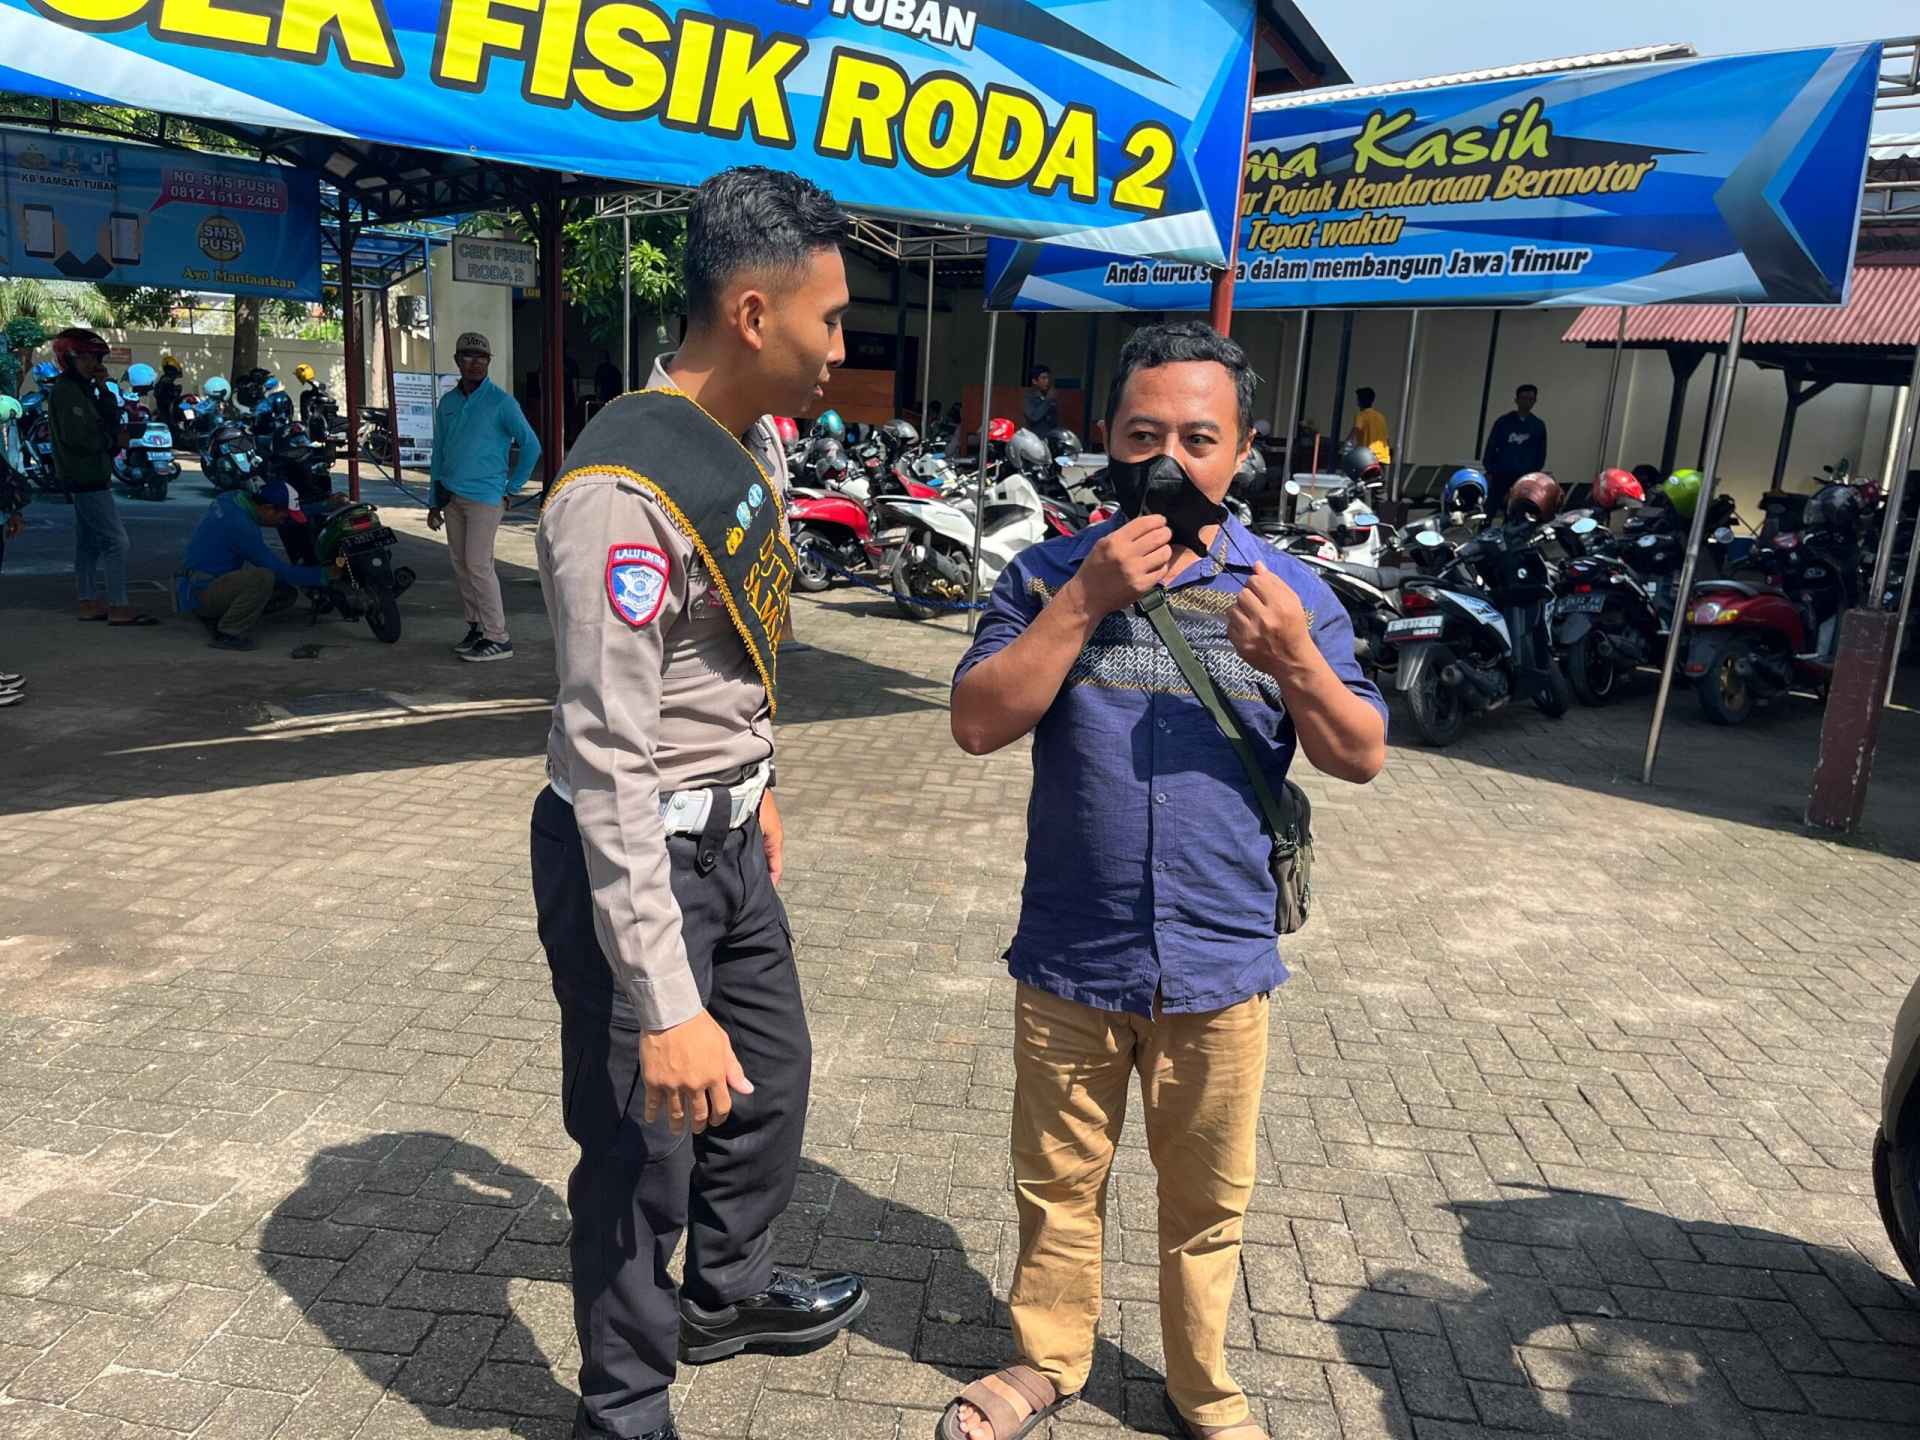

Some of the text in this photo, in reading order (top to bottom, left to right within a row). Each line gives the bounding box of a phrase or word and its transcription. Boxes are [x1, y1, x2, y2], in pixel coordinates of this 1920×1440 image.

[440, 0, 803, 142] FISIK
[820, 55, 1095, 198] RODA
[1113, 127, 1175, 210] 2
[1352, 101, 1550, 174] Kasih
[39, 175, 81, 187] SAMSAT
[170, 185, 206, 200] 0812
[203, 175, 233, 189] SMS
[238, 179, 276, 193] PUSH
[1262, 179, 1336, 217] Pajak
[1338, 173, 1493, 210] Kendaraan
[1493, 160, 1654, 200] Bermotor
[200, 225, 243, 253] SMS PUSH
[1247, 213, 1404, 253] Tepat waktu
[183, 266, 209, 281] Ayo
[1106, 264, 1148, 284] Anda
[1152, 264, 1196, 282] turut
[1250, 257, 1307, 281] dalam
[1312, 255, 1442, 281] membangun
[1449, 250, 1502, 275] Jawa
[1511, 248, 1588, 274] Timur
